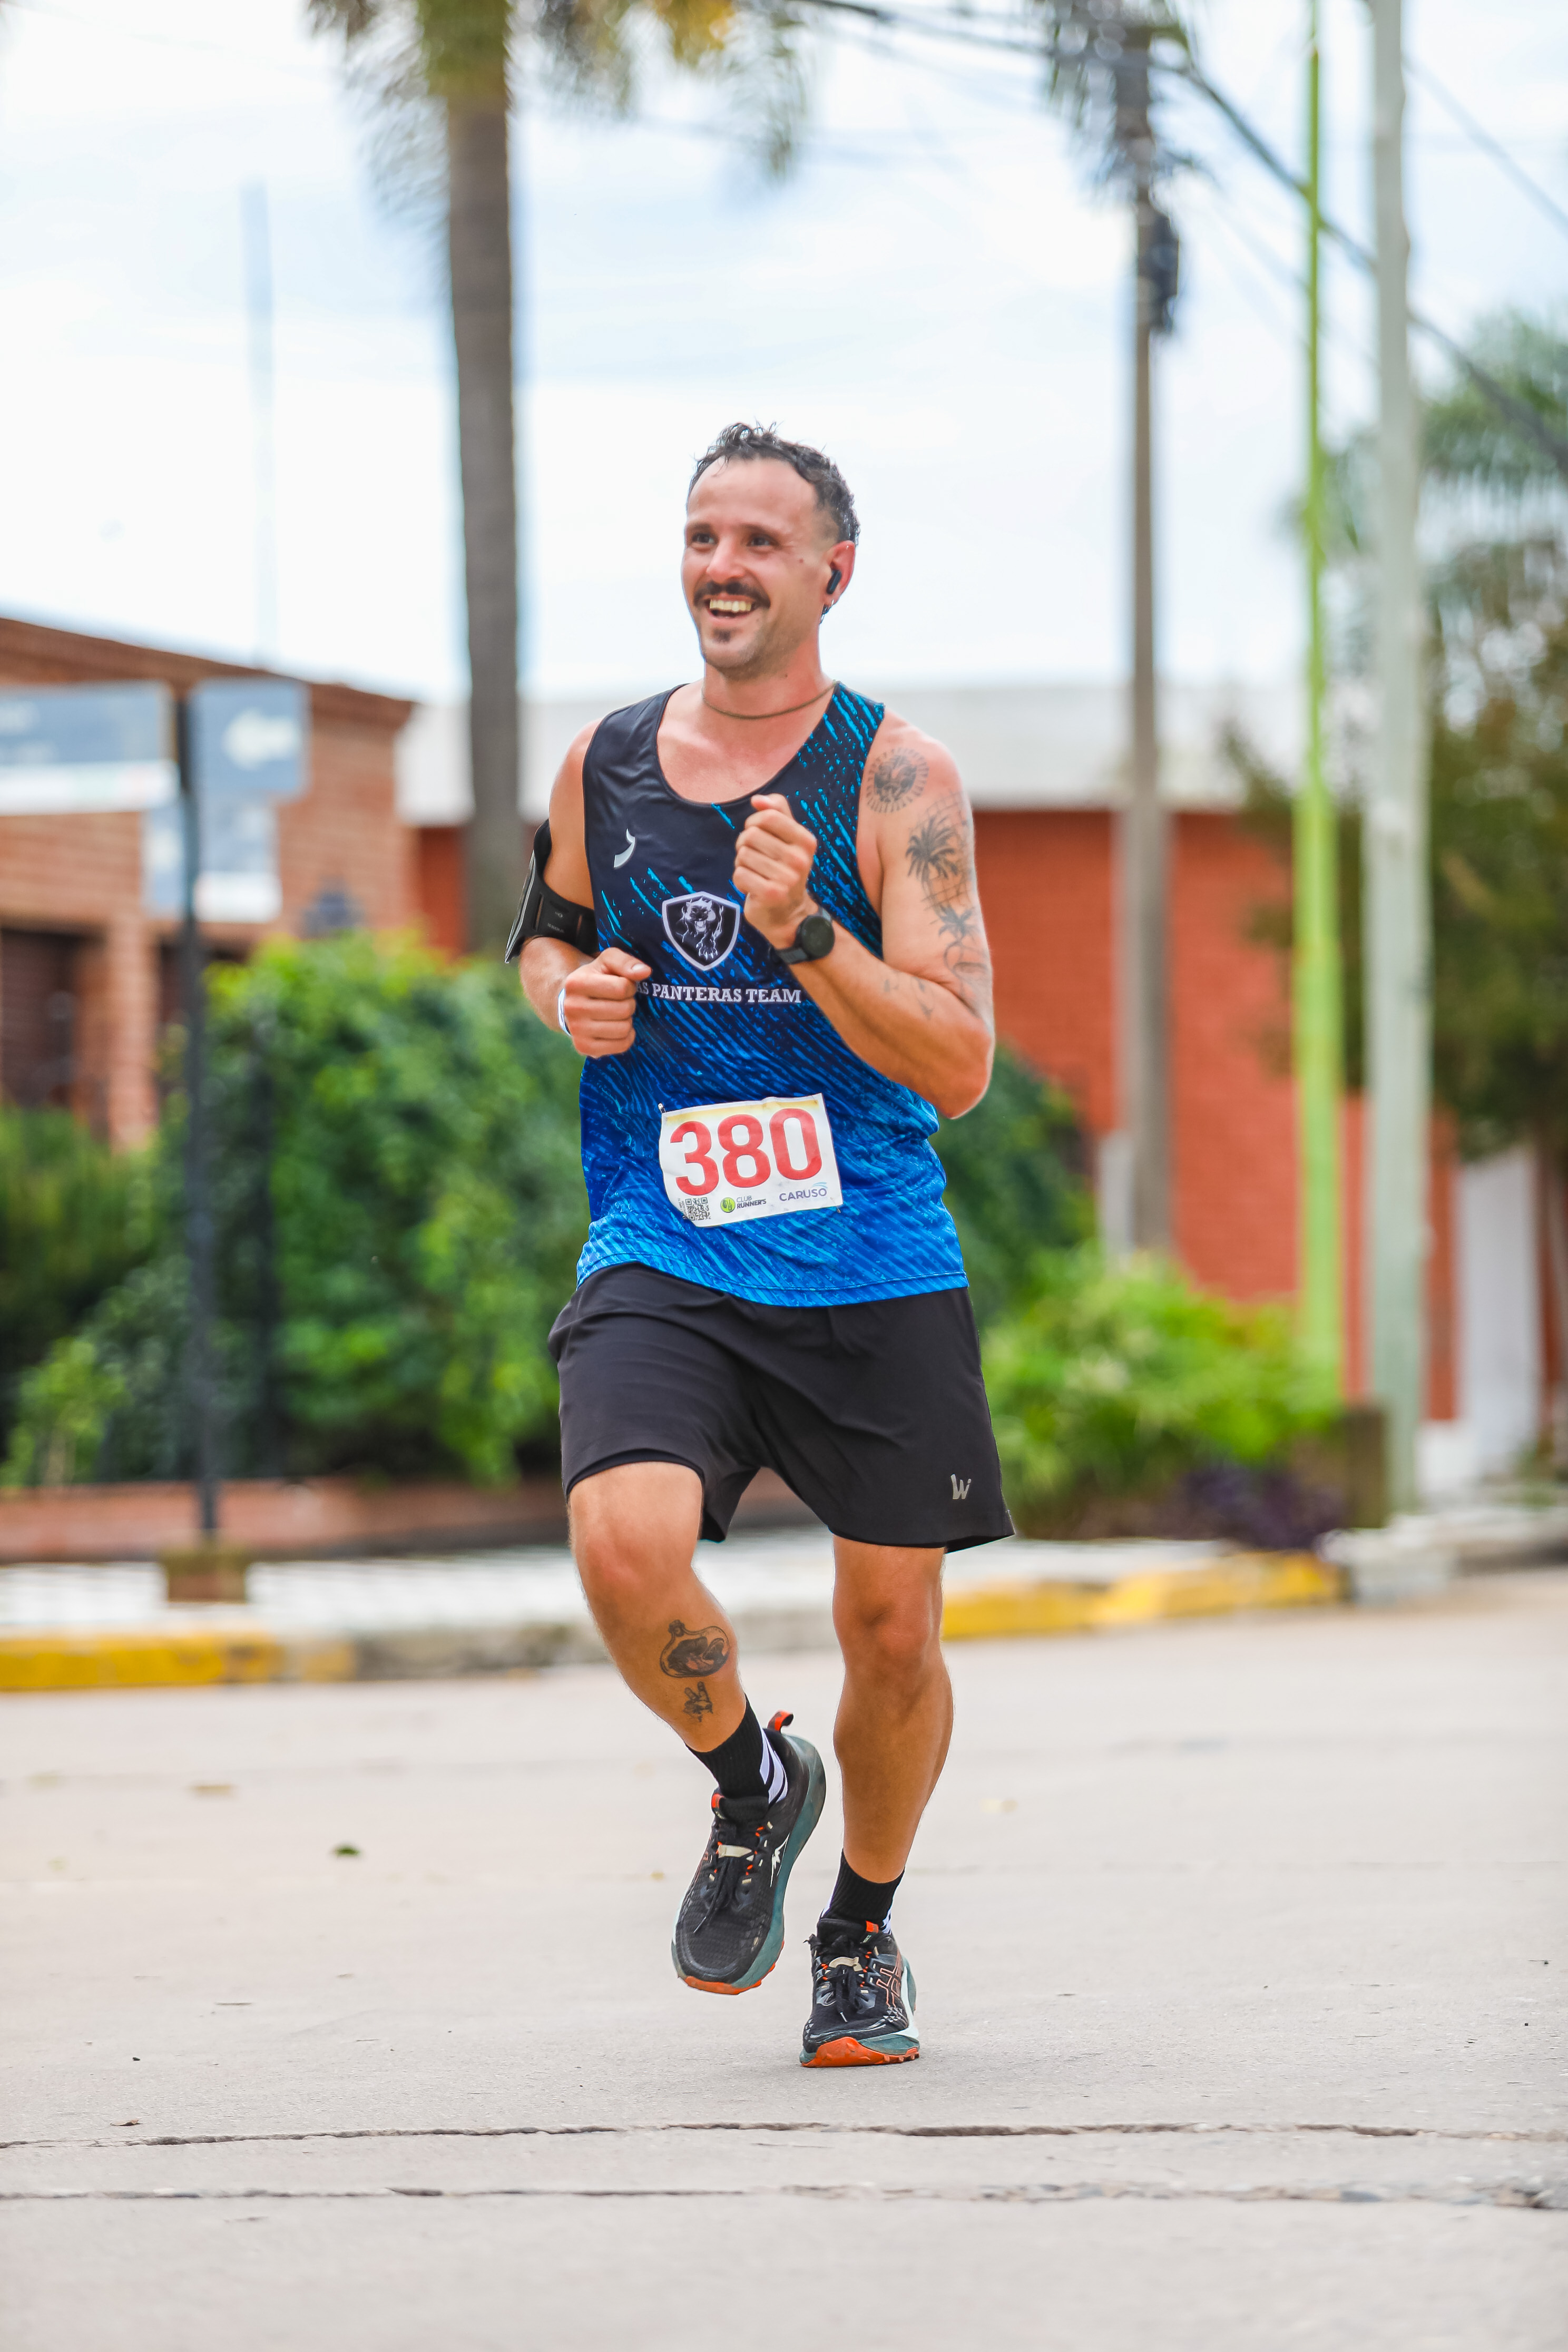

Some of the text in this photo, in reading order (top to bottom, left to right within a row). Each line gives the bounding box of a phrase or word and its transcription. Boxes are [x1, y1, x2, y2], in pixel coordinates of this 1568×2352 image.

[636, 982, 801, 1003] AS PANTERAS TEAM
[670, 1108, 822, 1195] 380
[779, 1188, 827, 1201] CARUSO
